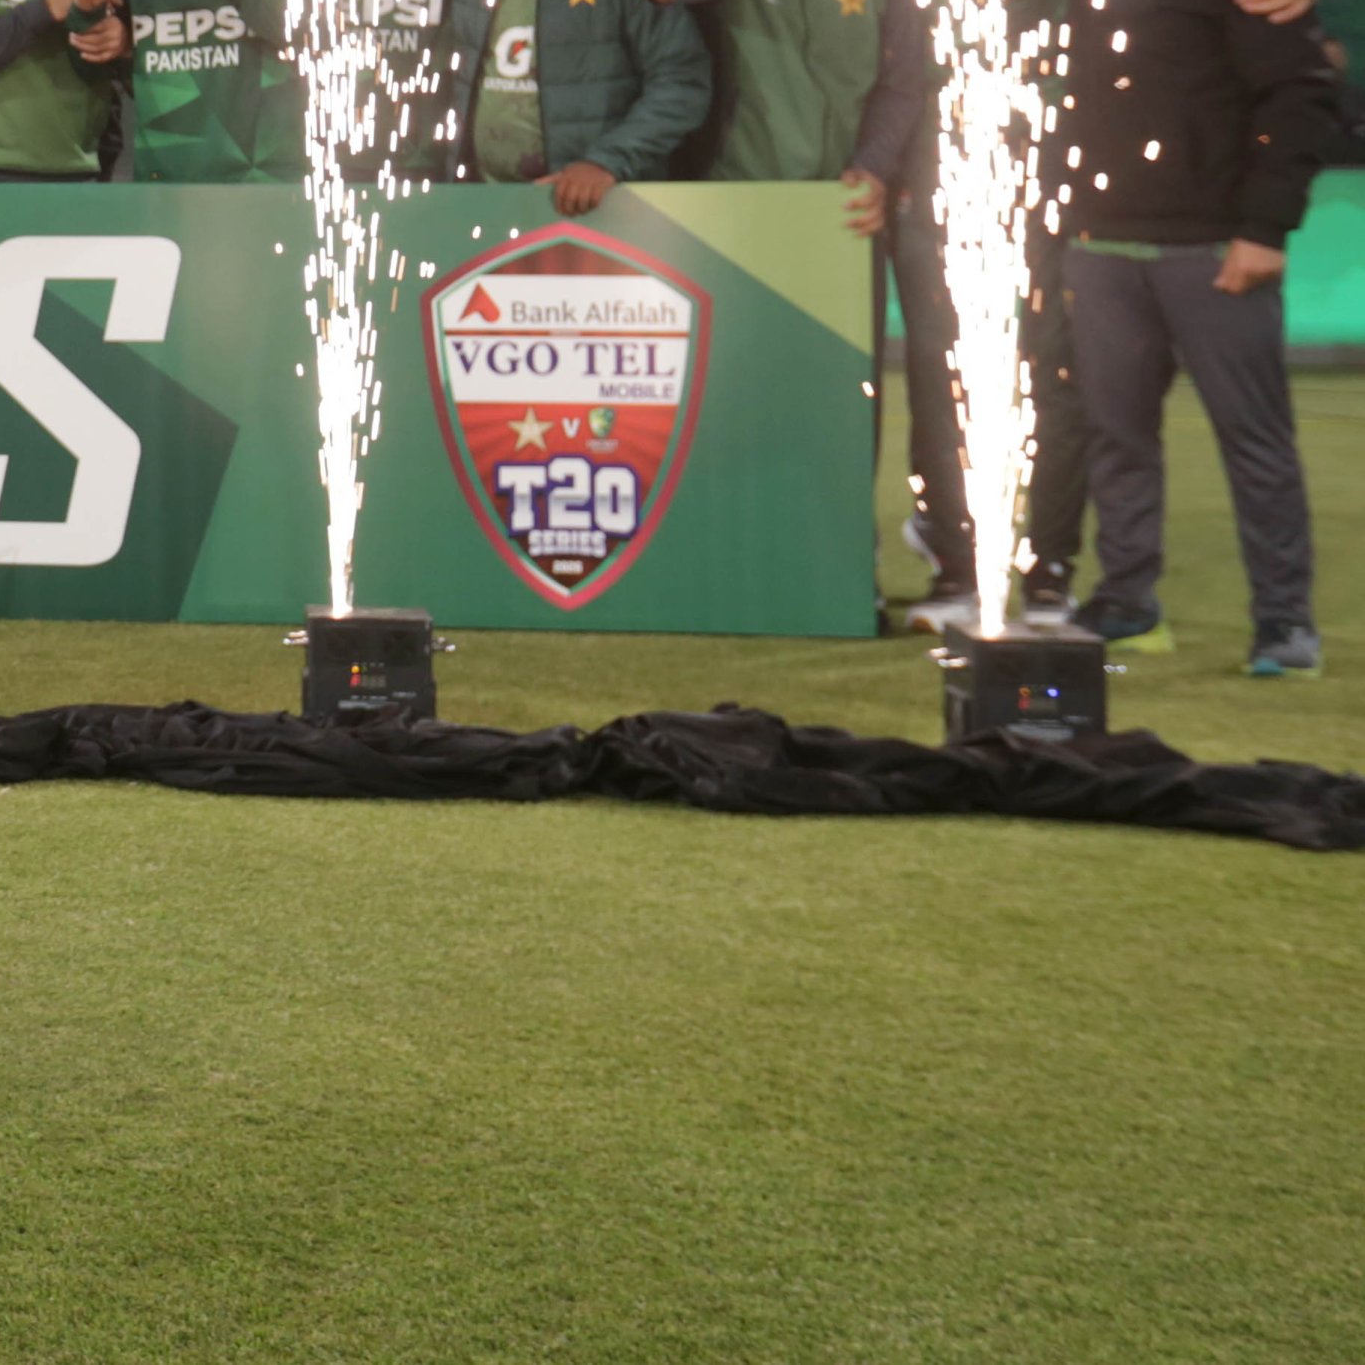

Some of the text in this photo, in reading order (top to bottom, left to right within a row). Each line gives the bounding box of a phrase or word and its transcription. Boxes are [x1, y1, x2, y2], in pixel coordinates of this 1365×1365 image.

[132, 5, 250, 46] PEPS
[145, 44, 240, 72] PAKISTAN
[494, 26, 536, 78] G
[511, 300, 677, 325] Bank Alfalah
[452, 339, 676, 377] VGO TEL
[599, 383, 674, 398] MOBILE
[498, 457, 635, 535] T20
[528, 530, 607, 557] SERIES
